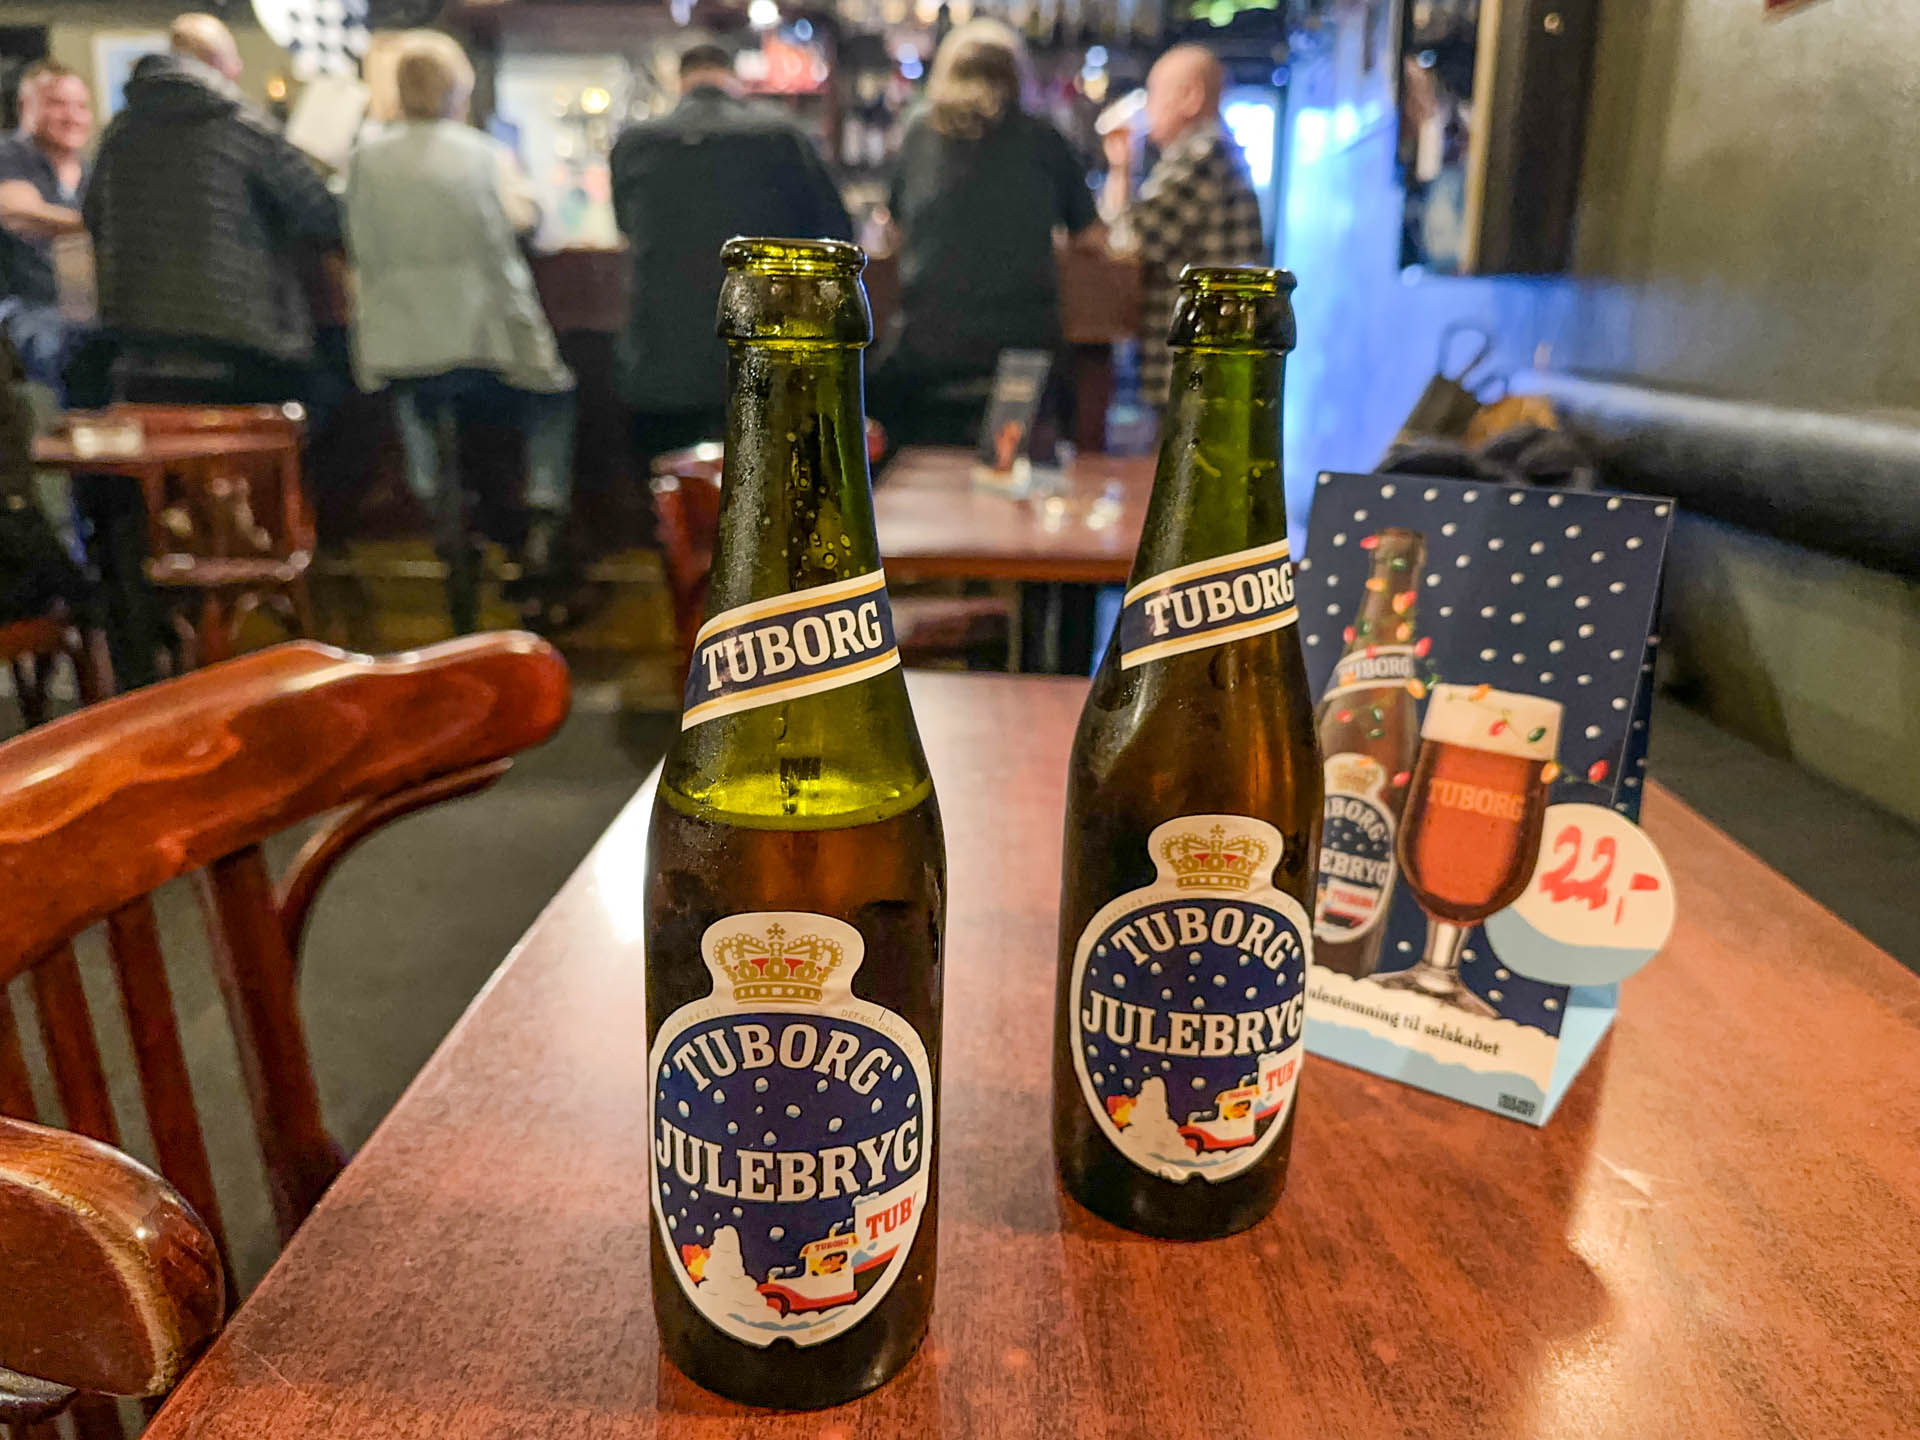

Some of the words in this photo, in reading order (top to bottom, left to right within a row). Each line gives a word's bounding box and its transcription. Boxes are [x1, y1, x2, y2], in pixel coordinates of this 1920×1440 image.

[1144, 562, 1295, 637] TUBORG
[702, 600, 883, 691] TUBORG
[1324, 797, 1386, 842] BORG
[1428, 781, 1525, 821] TUBORG
[1319, 849, 1389, 887] EBRYG
[1110, 906, 1296, 971] TUBORG
[1082, 990, 1303, 1057] JULEBRYG
[1307, 984, 1399, 1029] ulestemning
[1402, 1013, 1421, 1032] til
[1424, 1023, 1501, 1057] selskabet
[672, 1022, 893, 1097] TUBORG
[656, 1116, 920, 1202] JULEBRYG
